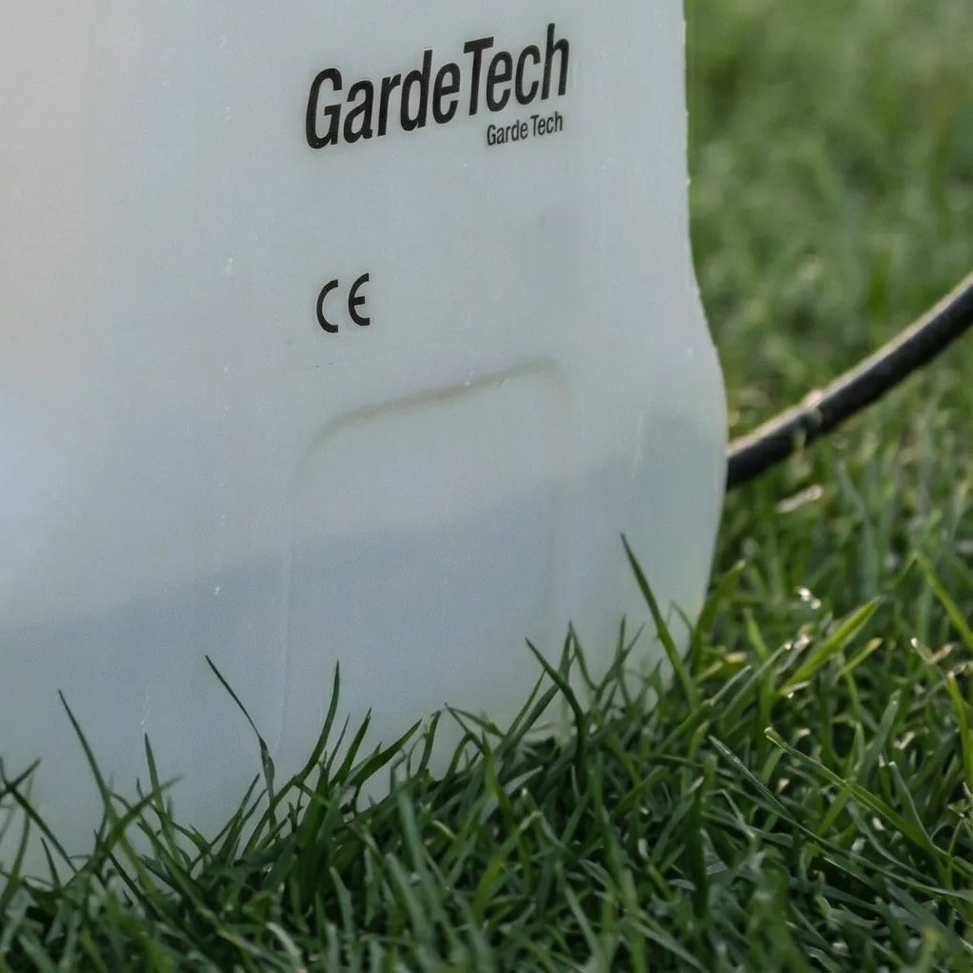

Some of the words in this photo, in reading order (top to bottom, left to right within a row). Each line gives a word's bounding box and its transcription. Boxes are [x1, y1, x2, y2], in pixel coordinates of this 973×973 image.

[305, 23, 570, 150] GardeTech
[487, 120, 528, 147] Garde
[530, 111, 564, 137] Tech
[316, 272, 371, 334] CE
